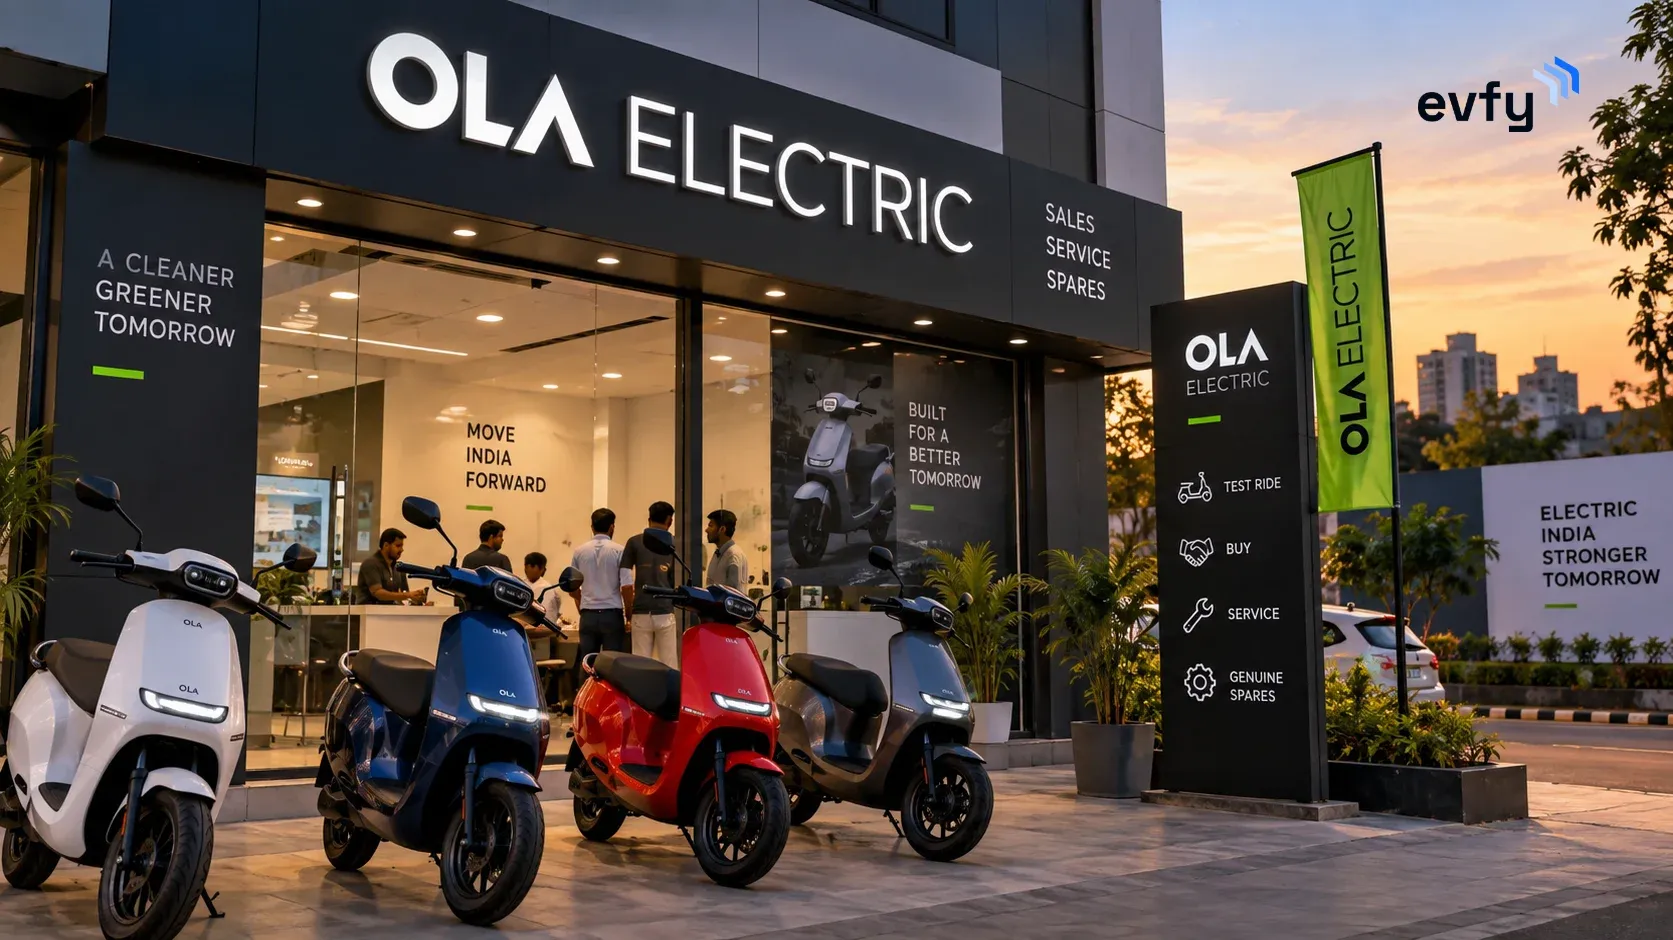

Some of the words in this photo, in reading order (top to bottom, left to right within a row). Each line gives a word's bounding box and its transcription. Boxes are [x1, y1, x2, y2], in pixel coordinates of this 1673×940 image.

[366, 32, 595, 168] OLA
[626, 94, 974, 254] ELECTRIC
[1045, 202, 1095, 234] SALES
[1046, 235, 1112, 270] SERVICE
[97, 248, 114, 270] A
[126, 252, 234, 289] CLEANER
[1046, 269, 1106, 301] SPARES
[1326, 206, 1364, 368] ELECTRIC
[95, 279, 212, 315] GREENER
[94, 310, 236, 348] TOMORROW
[1185, 327, 1269, 371] OLA
[1186, 369, 1270, 396] ELECTRIC
[908, 401, 947, 422] BUILT
[1337, 371, 1369, 456] OLA
[466, 422, 515, 443] MOVE
[908, 423, 936, 442] FOR
[940, 428, 949, 443] A
[466, 447, 512, 467] INDIA
[909, 446, 961, 466] BETTER
[466, 471, 547, 493] FORWARD
[909, 468, 982, 490] TOMORROW
[1223, 479, 1252, 493] TEST
[1255, 476, 1282, 491] RIDE
[1540, 500, 1638, 521] ELECTRIC
[1541, 525, 1596, 544] INDIA
[1226, 541, 1251, 555] BUY
[1542, 546, 1648, 566] STRONGER
[1542, 568, 1661, 588] TOMORROW
[183, 618, 203, 629] OLA
[1227, 607, 1280, 620] SERVICE
[1229, 670, 1284, 685] GENUINE
[178, 684, 199, 695] OLA
[1230, 689, 1276, 703] SPARES
